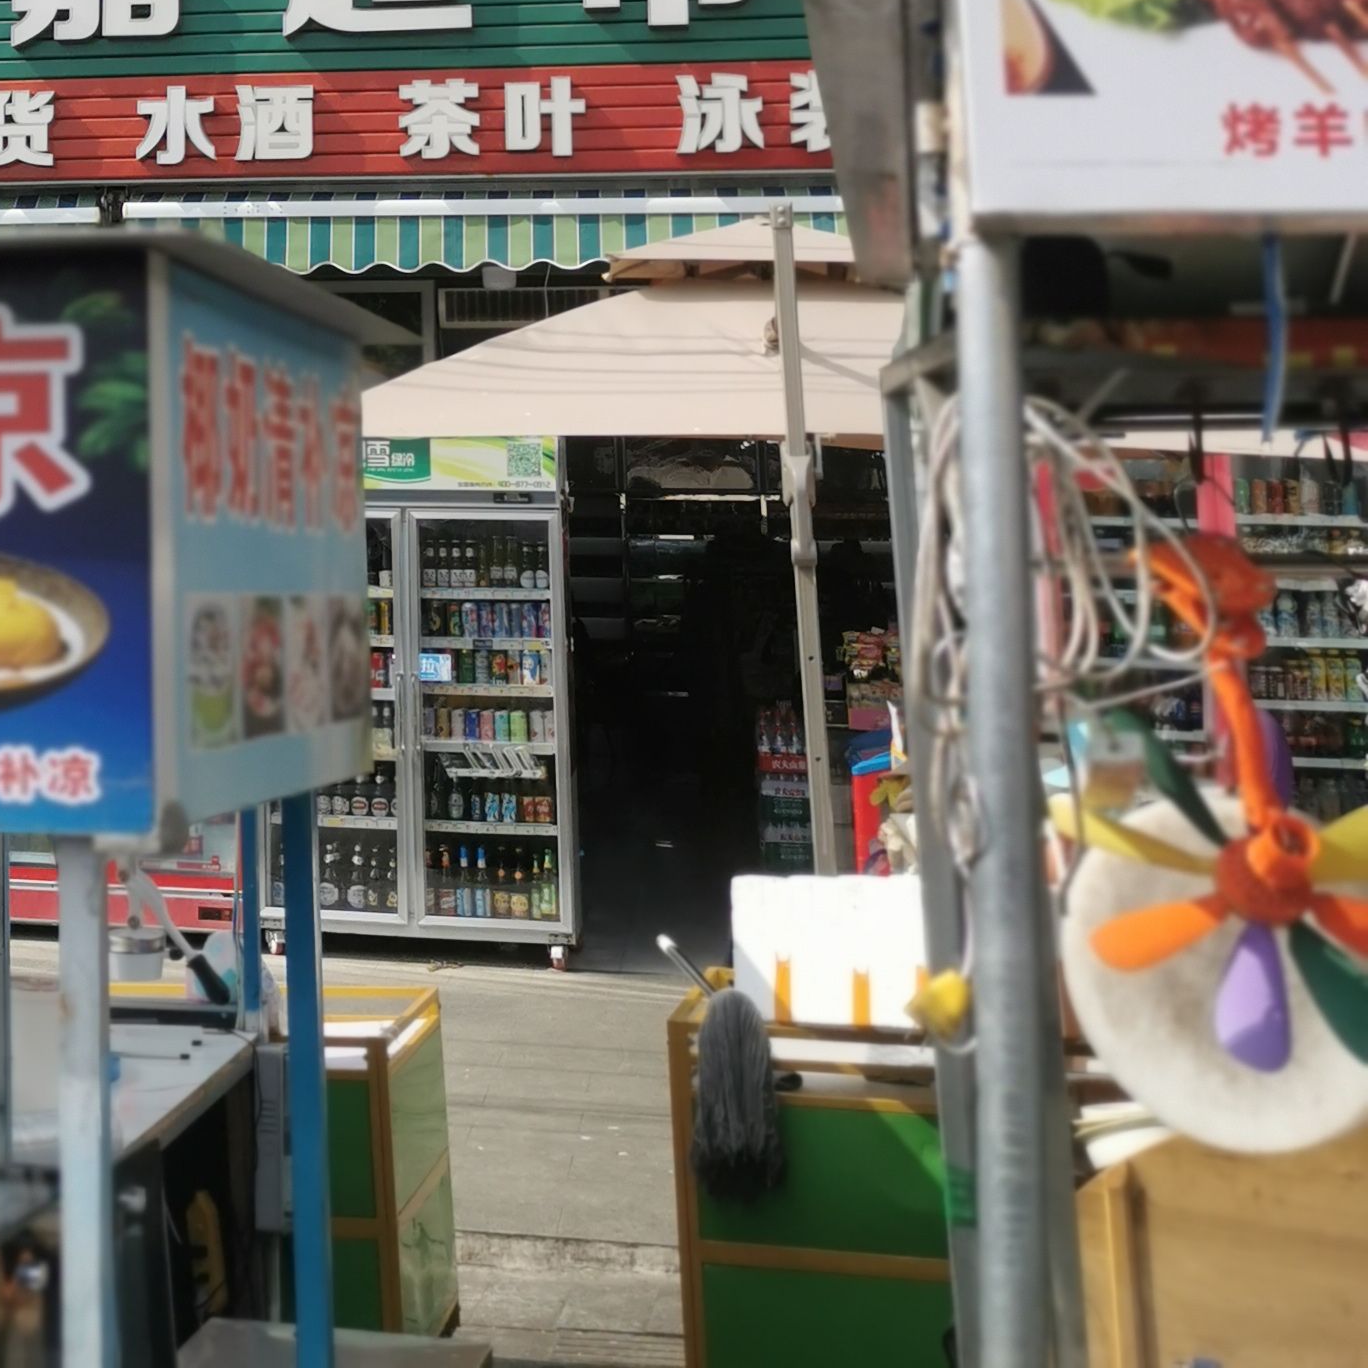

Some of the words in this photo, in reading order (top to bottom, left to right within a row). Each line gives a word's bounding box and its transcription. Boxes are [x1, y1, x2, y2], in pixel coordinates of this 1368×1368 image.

[136, 84, 316, 166] 水酒
[398, 75, 587, 160] 茶叶
[1220, 102, 1368, 158] 烤羊
